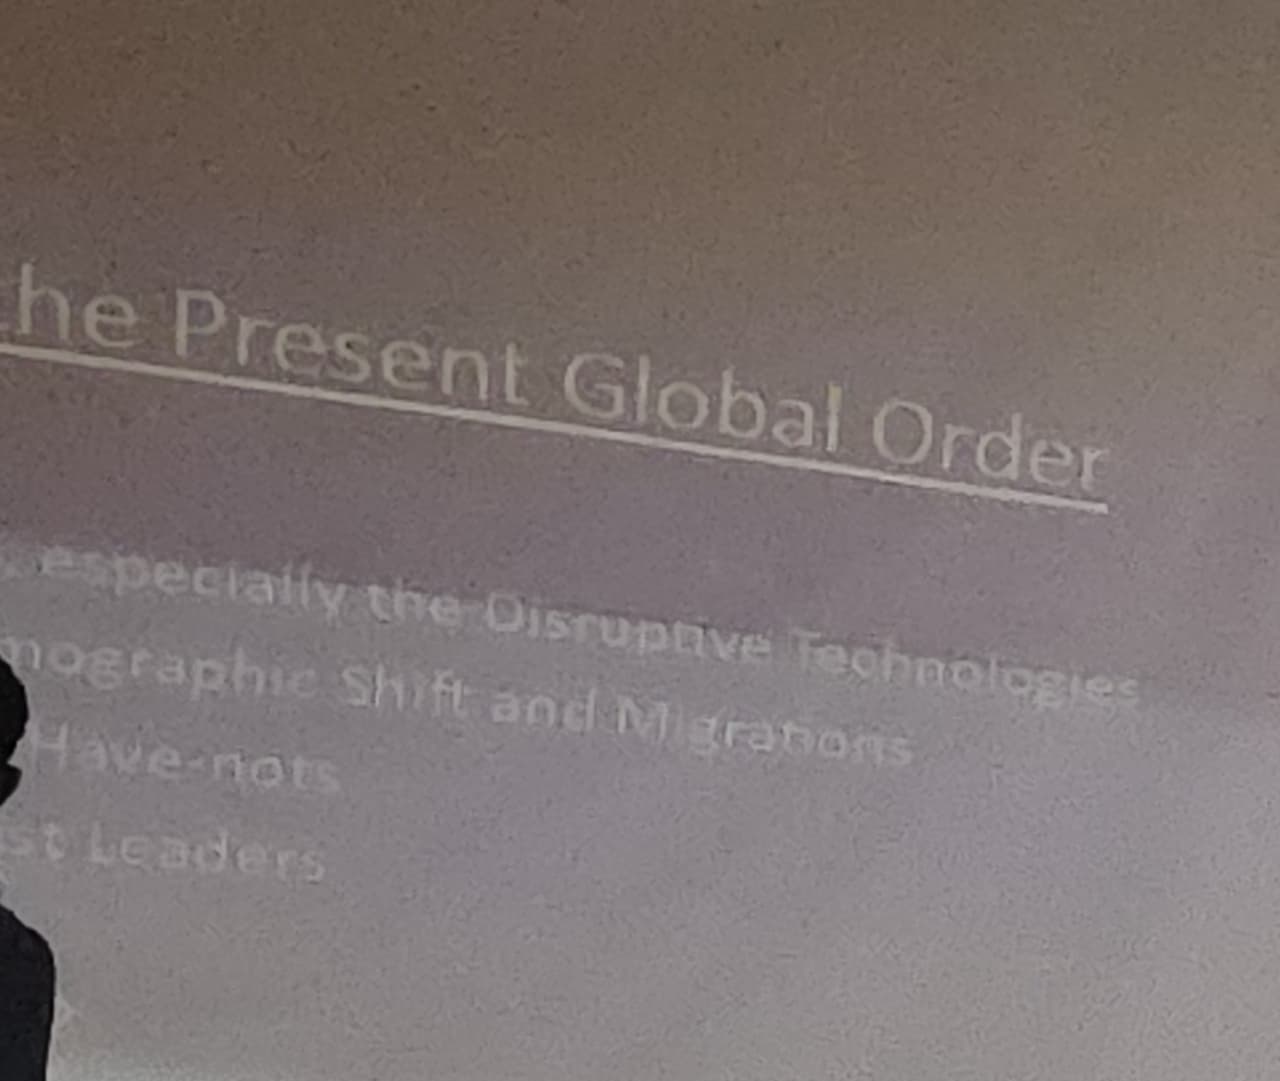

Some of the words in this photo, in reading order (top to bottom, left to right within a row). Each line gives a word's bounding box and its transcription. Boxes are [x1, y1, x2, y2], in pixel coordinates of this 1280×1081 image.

[0, 262, 138, 349] he
[174, 287, 528, 406] Present
[563, 352, 843, 452] Global
[872, 400, 1108, 490] Order
[41, 546, 346, 622] especially
[367, 580, 462, 627] the
[485, 590, 772, 664] Disruptive
[790, 624, 1140, 709] Technologies
[342, 662, 467, 717] Shift
[491, 686, 597, 733] and
[617, 694, 914, 766] Migrations
[89, 820, 326, 882] Leaders
